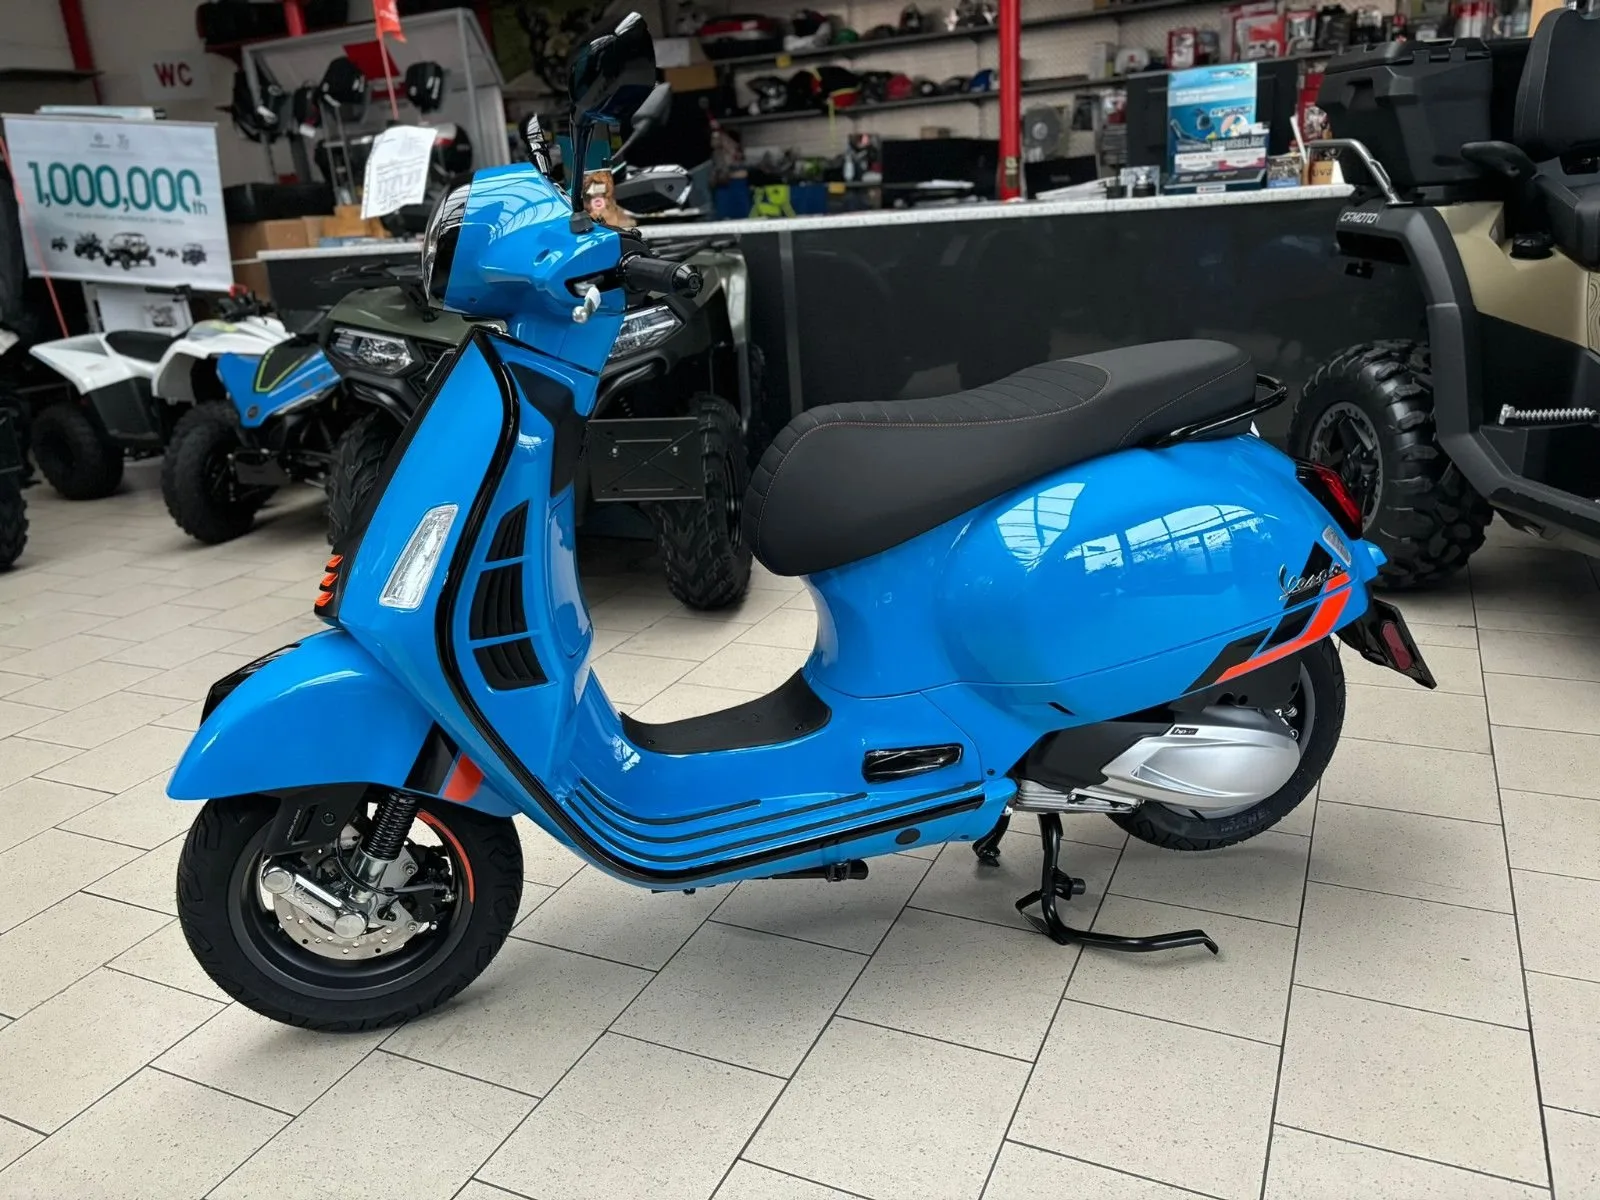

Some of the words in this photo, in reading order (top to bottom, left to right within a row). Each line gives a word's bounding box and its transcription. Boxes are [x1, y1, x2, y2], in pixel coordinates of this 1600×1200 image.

[153, 62, 193, 87] WC
[1340, 211, 1378, 224] CFMOTO
[1279, 563, 1342, 601] Vespa
